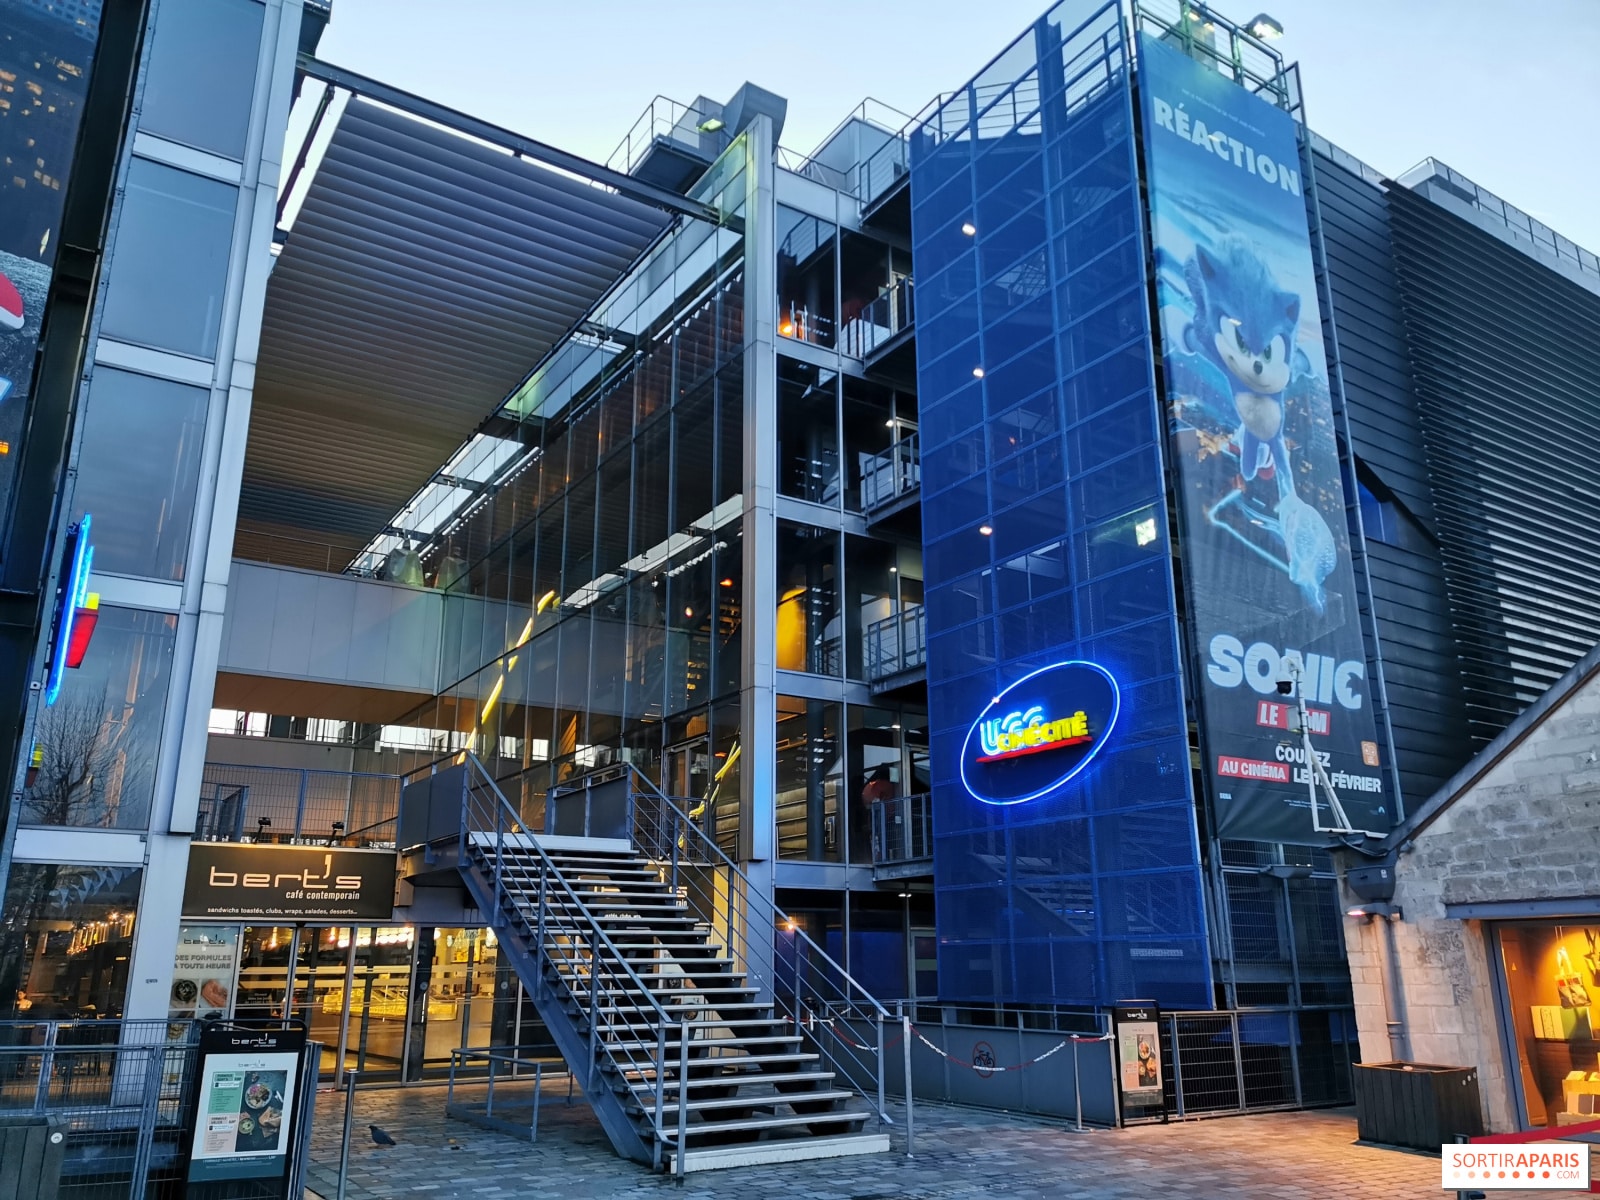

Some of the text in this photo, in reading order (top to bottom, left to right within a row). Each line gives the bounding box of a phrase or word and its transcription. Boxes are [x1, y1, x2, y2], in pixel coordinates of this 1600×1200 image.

[1153, 96, 1300, 197] RÉACTION
[1260, 703, 1279, 726] LE
[1275, 745, 1331, 768] COUEZ
[1221, 760, 1239, 774] AU
[1241, 762, 1286, 780] CINÉMA
[1293, 767, 1310, 785] LE
[1331, 769, 1382, 793] FÉVRIER
[209, 854, 362, 889] bert's
[286, 889, 360, 902] café contemporain
[231, 1033, 277, 1045] bert's
